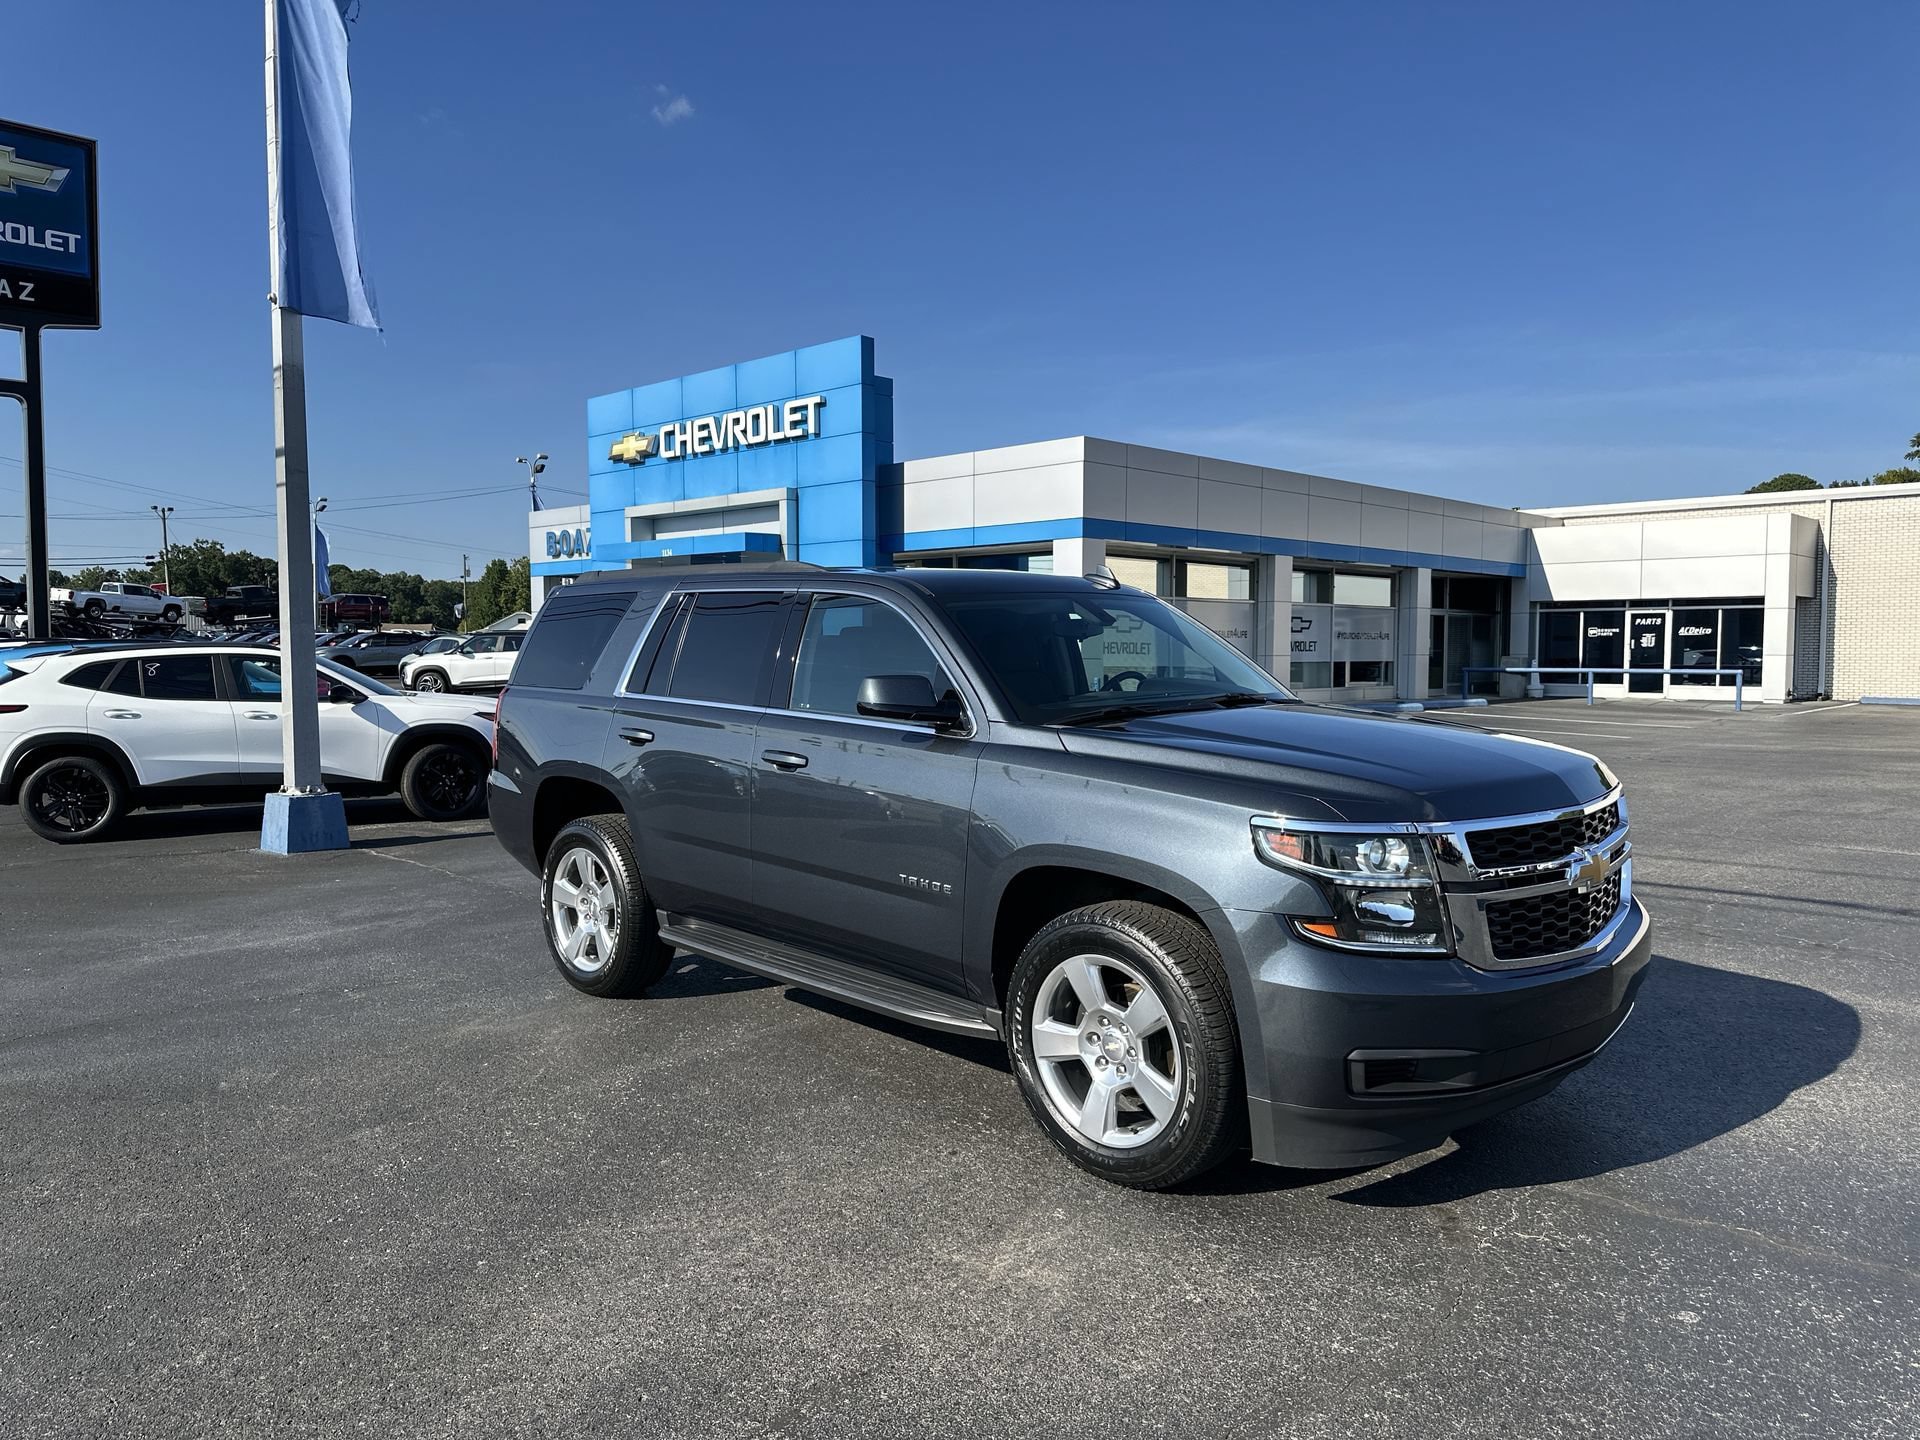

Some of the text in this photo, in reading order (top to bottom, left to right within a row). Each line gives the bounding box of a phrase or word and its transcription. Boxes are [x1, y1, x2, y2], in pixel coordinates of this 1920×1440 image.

[659, 395, 826, 460] CHEVROLET
[1678, 626, 1713, 636] ACDelco
[144, 662, 161, 676] 8
[899, 873, 952, 896] TAHOE
